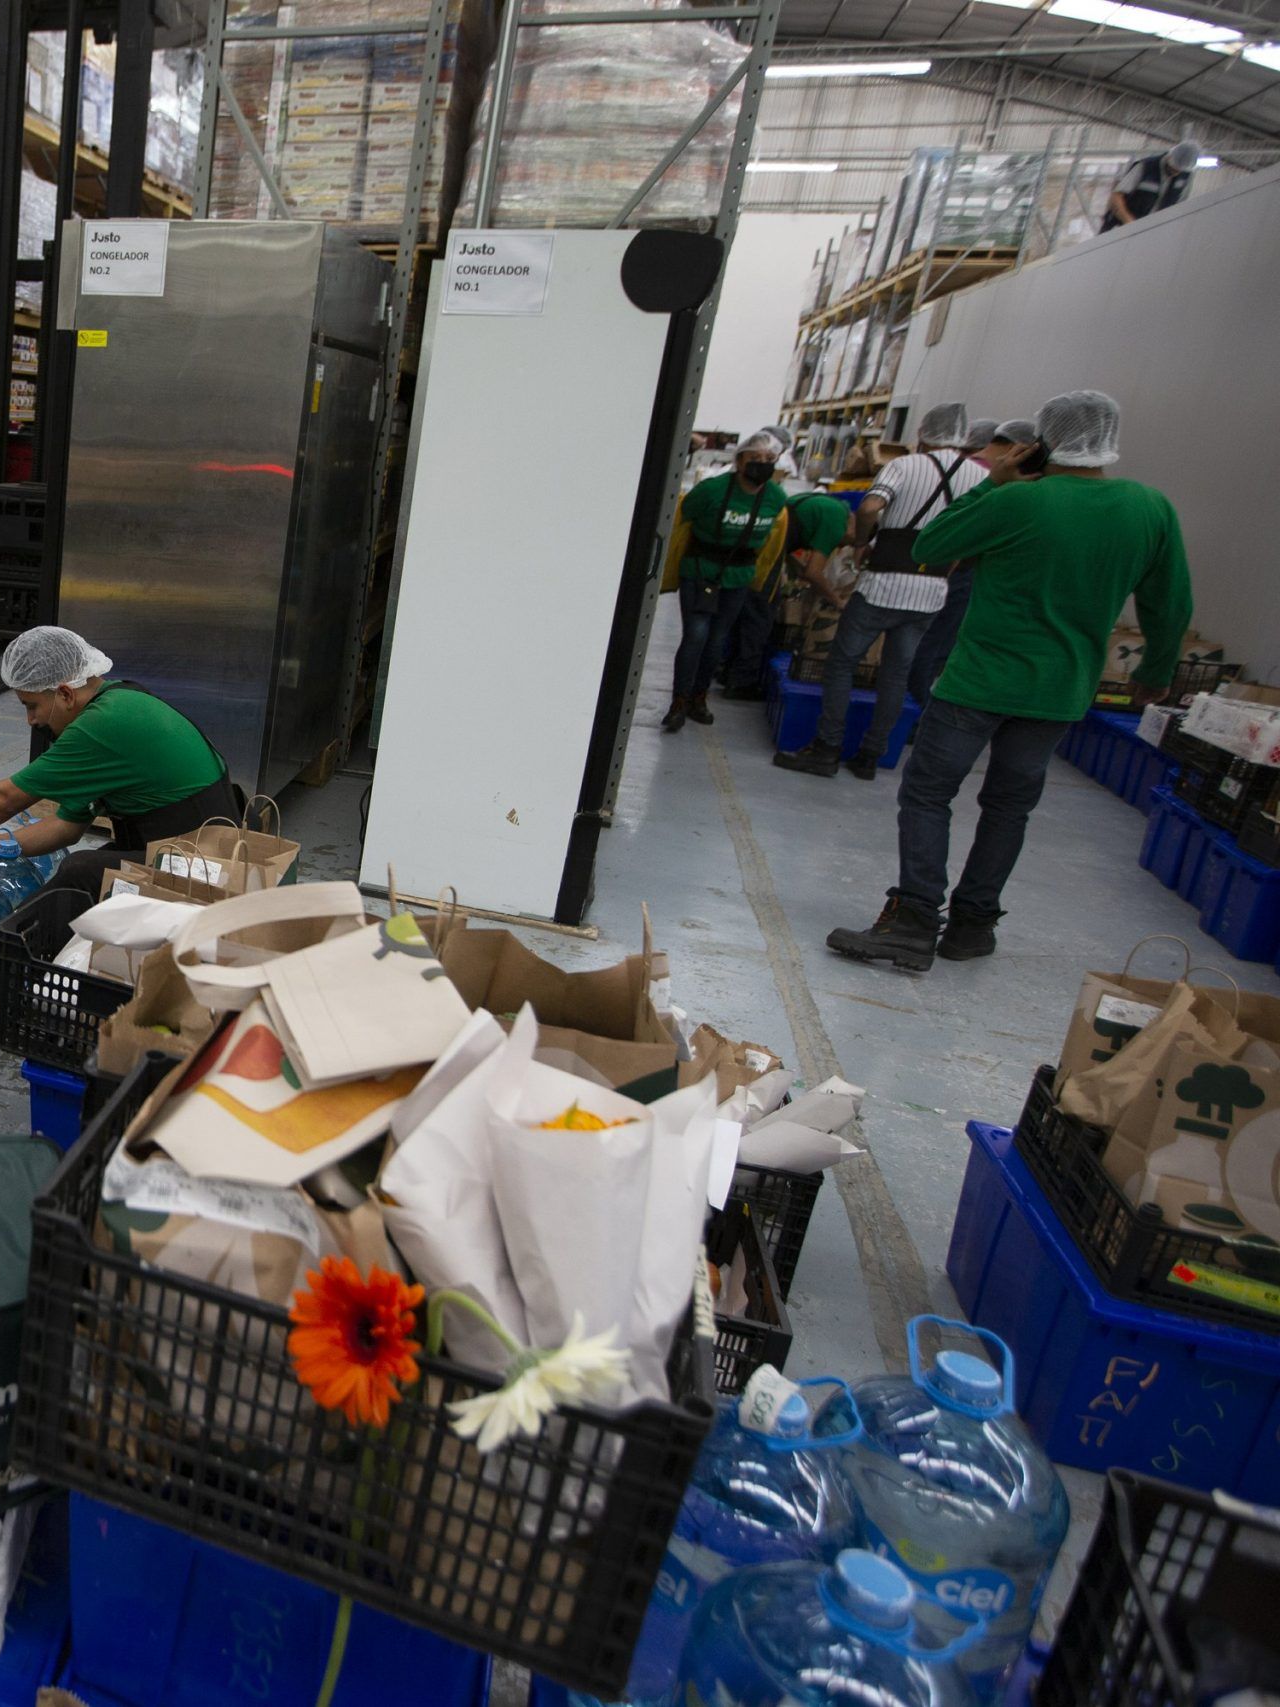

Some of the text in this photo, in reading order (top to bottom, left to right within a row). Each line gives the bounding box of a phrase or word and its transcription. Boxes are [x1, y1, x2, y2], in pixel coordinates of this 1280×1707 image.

[89, 251, 150, 261] CONGELADOR
[88, 266, 111, 275] NO.2
[455, 264, 530, 276] CONGELADOR
[453, 281, 480, 292] NO.1
[934, 1574, 1010, 1614] ciel
